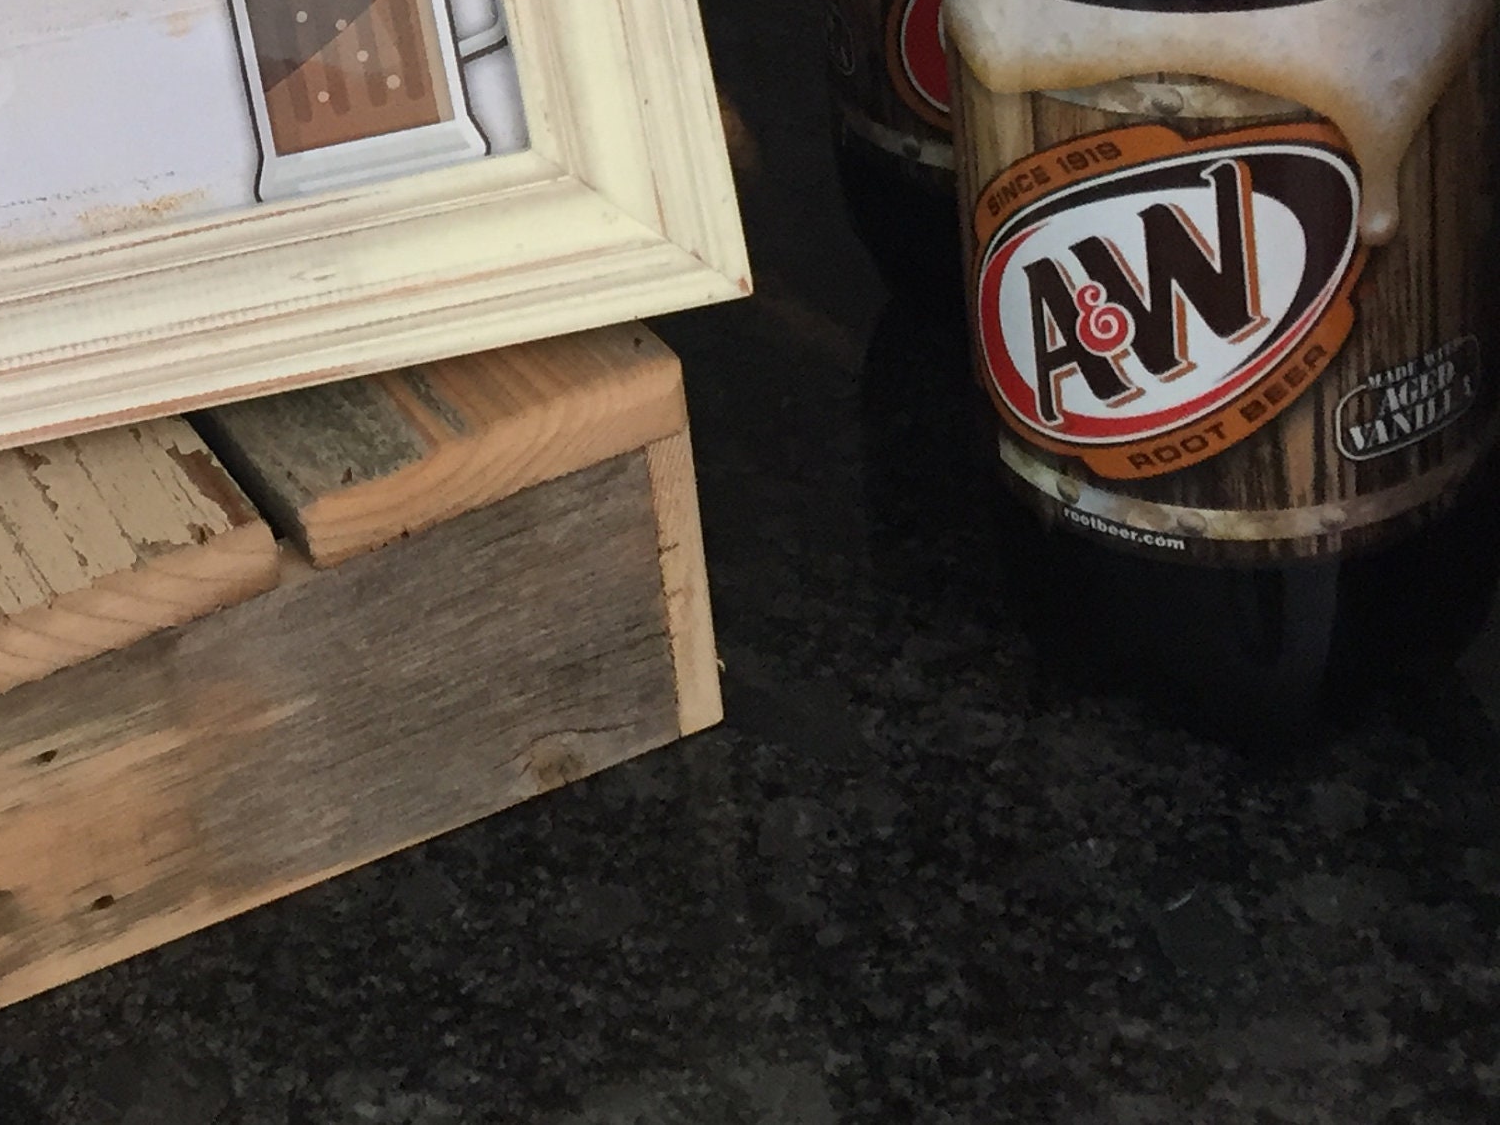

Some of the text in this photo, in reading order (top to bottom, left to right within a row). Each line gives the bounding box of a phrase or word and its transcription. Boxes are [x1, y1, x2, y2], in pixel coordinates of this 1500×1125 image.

[987, 165, 1050, 217] SINCE
[1021, 158, 1271, 427] A&W
[1127, 344, 1328, 471] ROOT BEER
[1063, 505, 1186, 551] rootbeer.com
